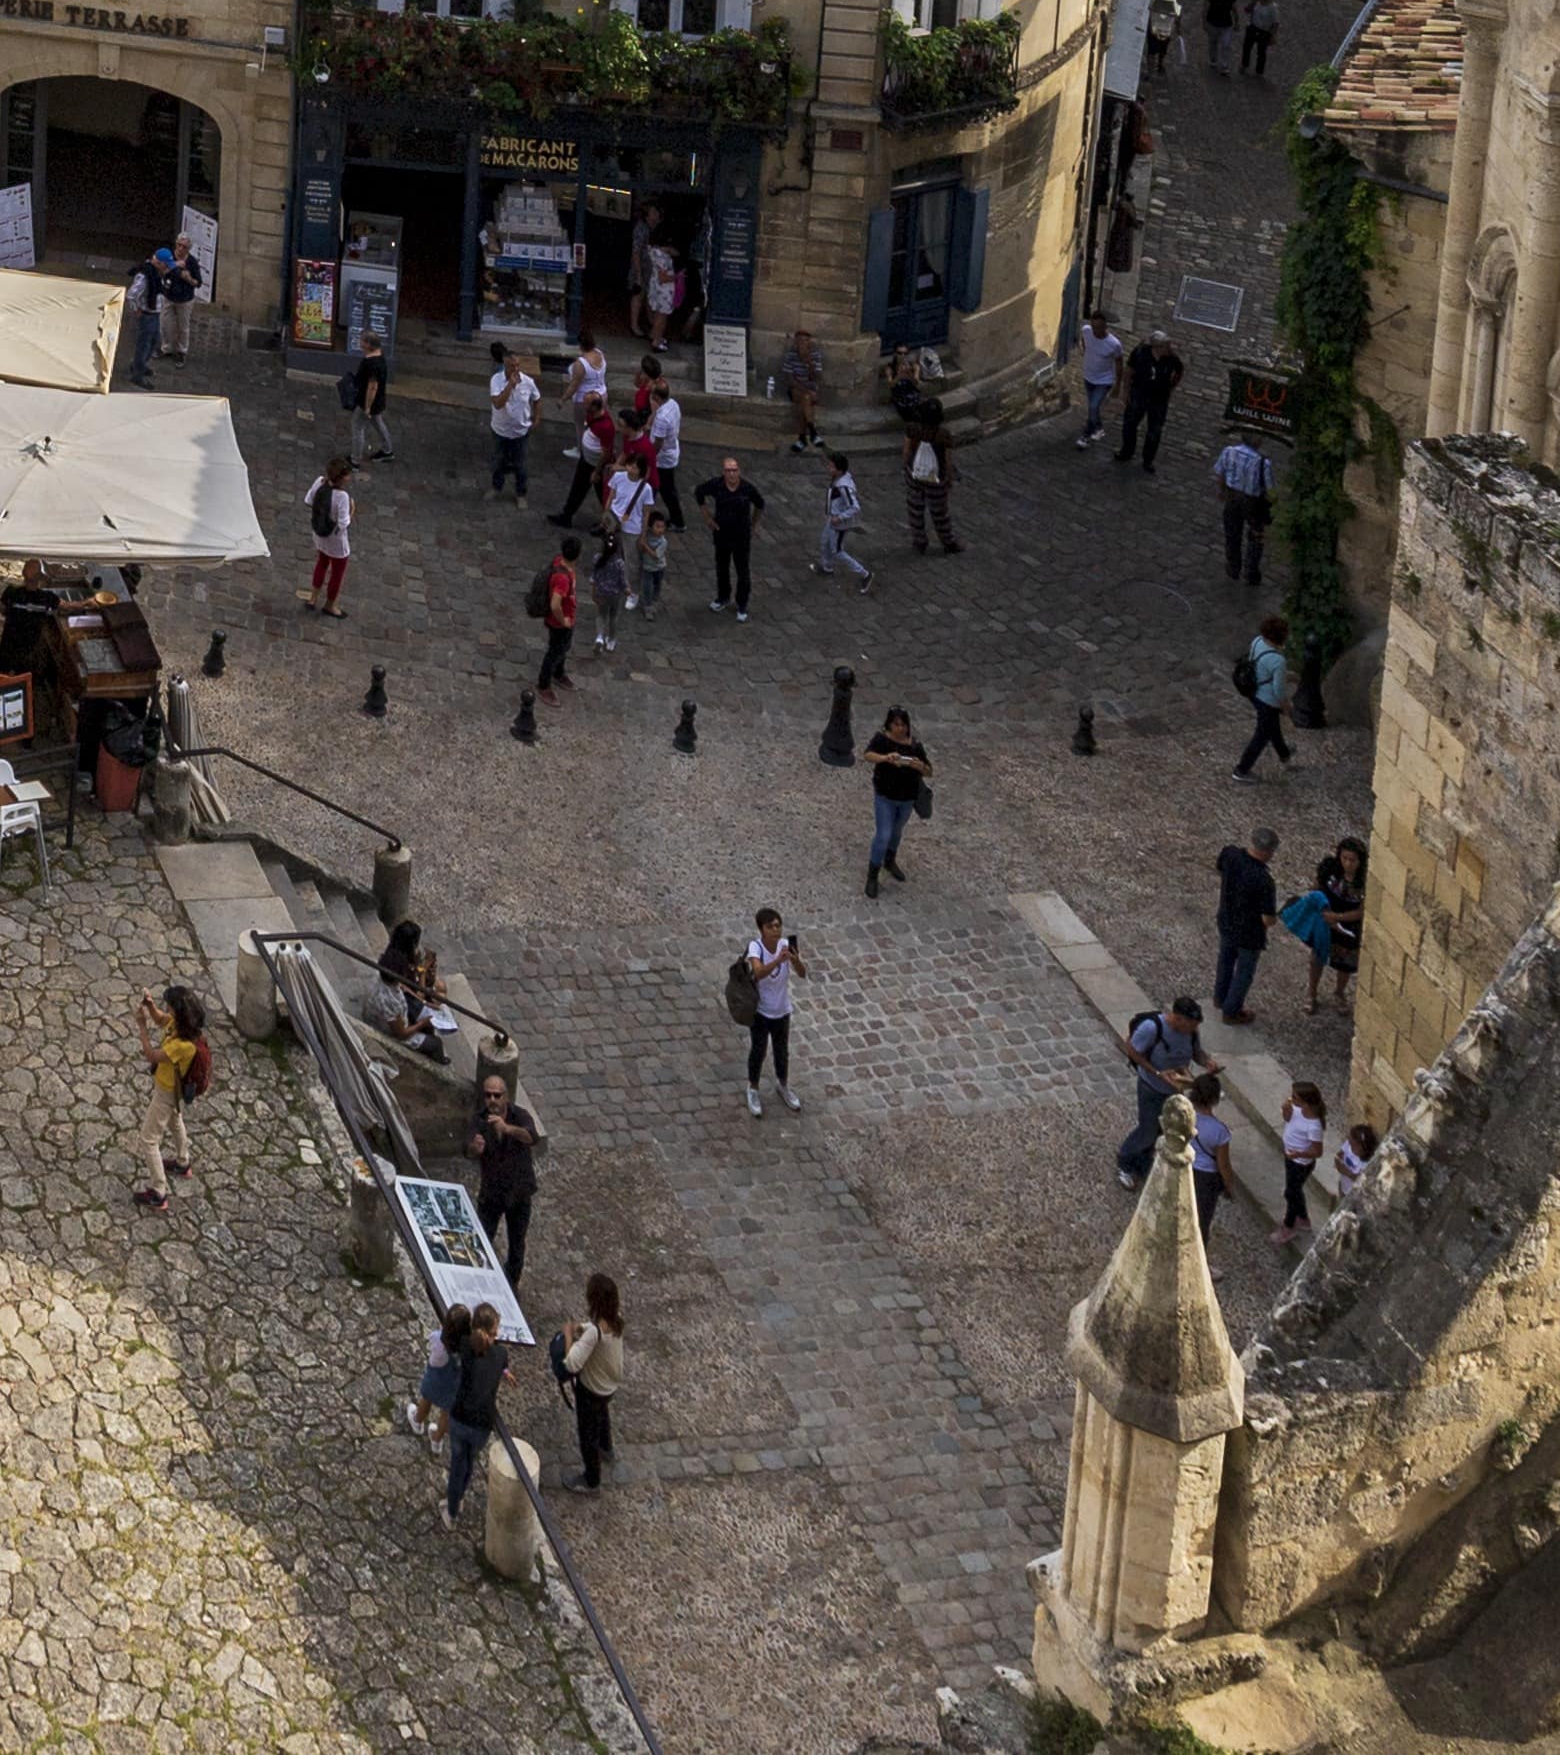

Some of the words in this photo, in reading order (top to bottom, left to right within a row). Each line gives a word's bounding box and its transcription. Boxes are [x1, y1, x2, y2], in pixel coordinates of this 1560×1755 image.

[66, 5, 190, 36] TERRASSE
[480, 136, 576, 156] FABRICANT
[492, 152, 579, 171] MACARONS
